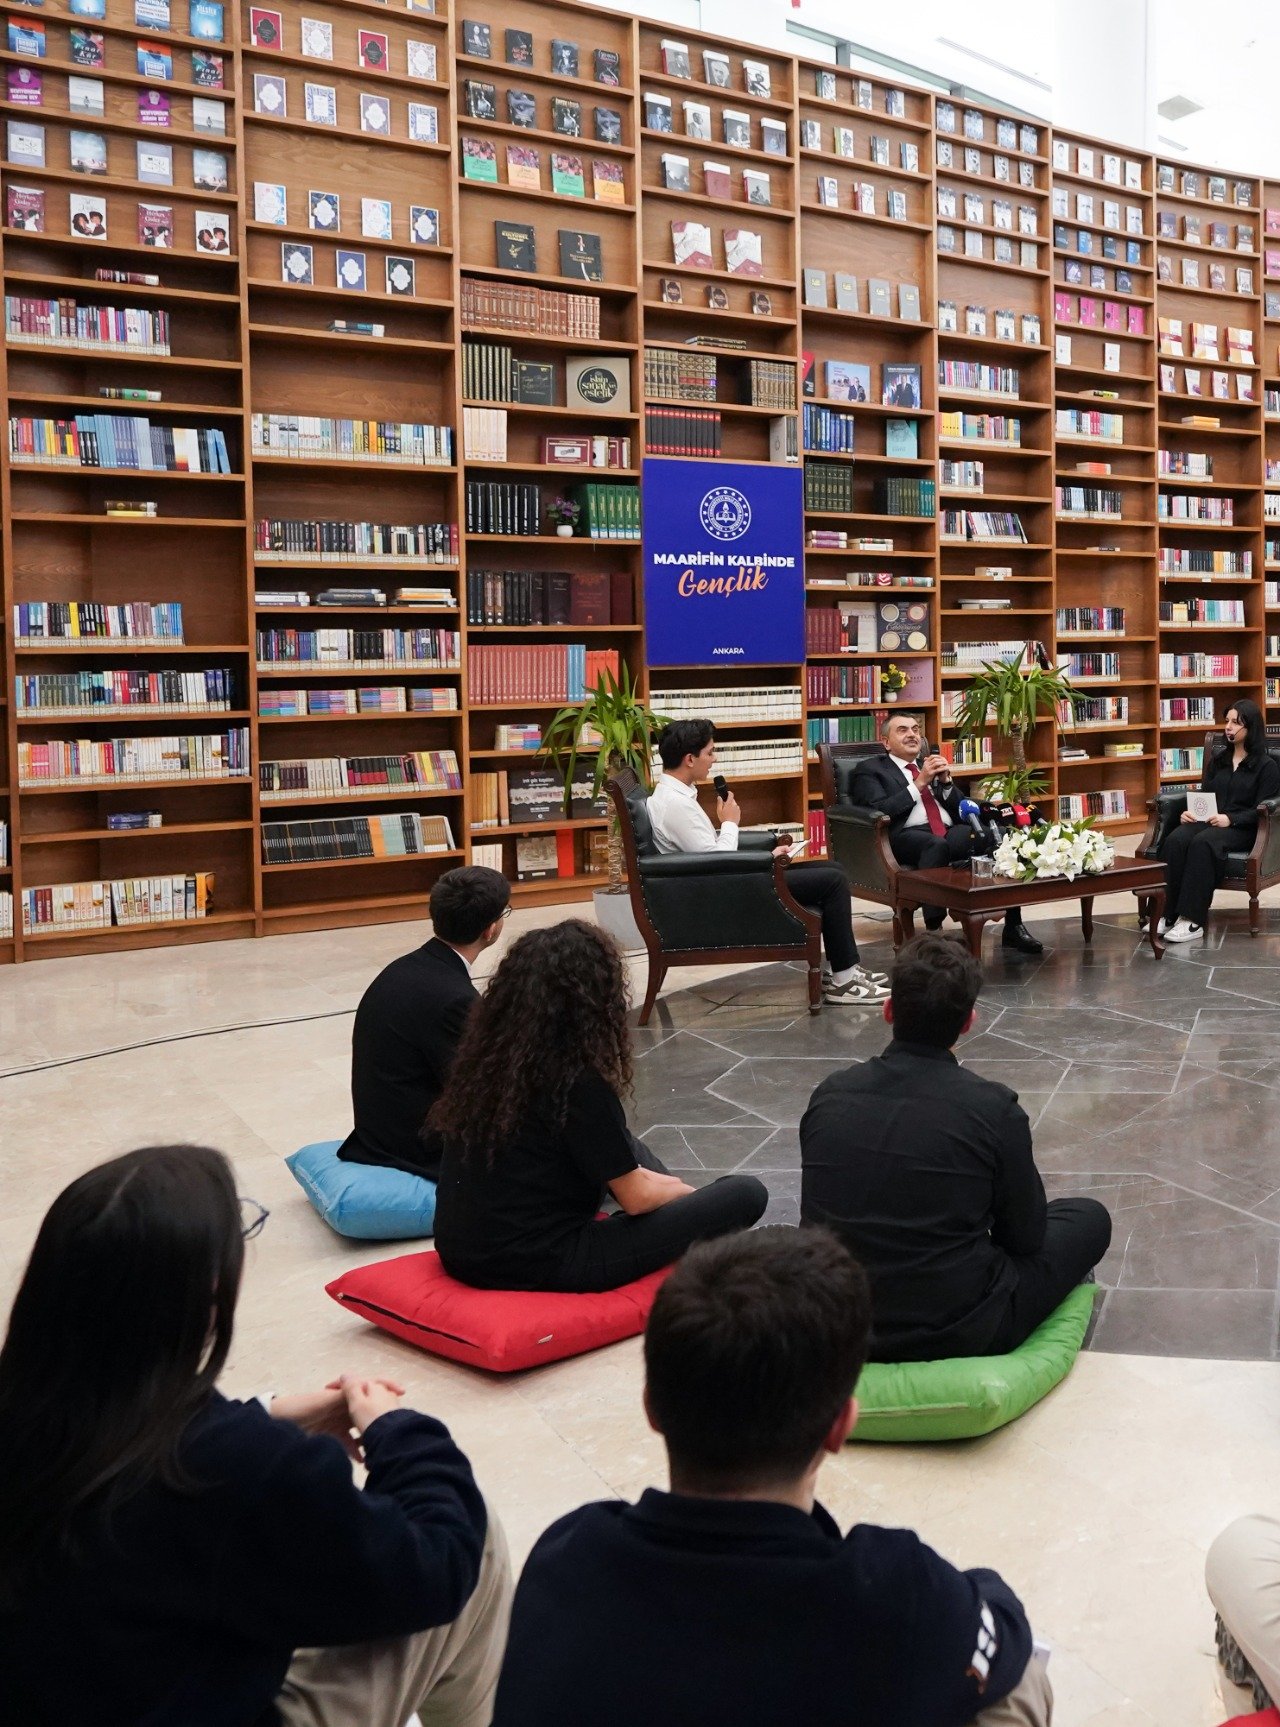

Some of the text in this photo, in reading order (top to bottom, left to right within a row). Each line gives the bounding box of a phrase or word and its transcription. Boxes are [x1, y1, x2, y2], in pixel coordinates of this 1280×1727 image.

[653, 552, 795, 568] MAARİFİN KALBİNDE
[677, 565, 770, 598] Gençlik
[712, 647, 745, 655] ANKARA
